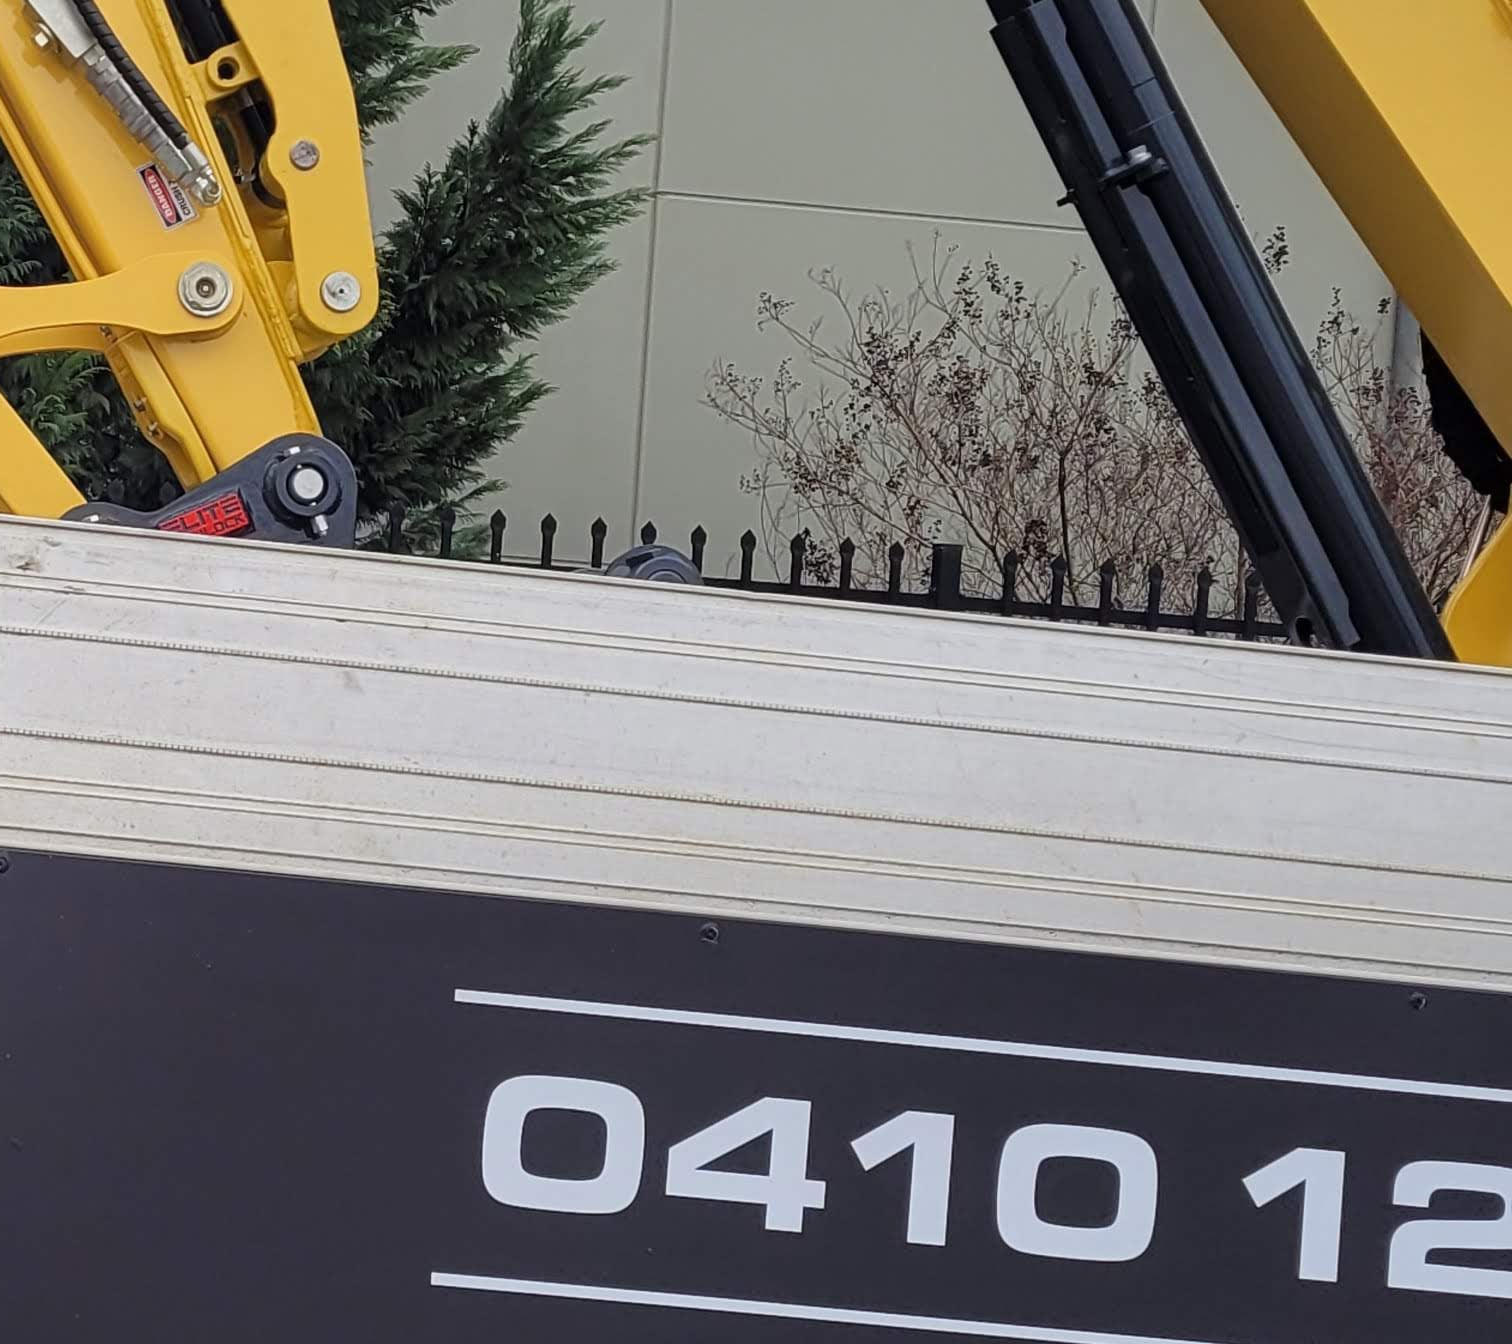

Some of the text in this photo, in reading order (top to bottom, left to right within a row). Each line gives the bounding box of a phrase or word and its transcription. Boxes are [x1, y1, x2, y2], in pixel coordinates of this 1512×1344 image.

[148, 175, 173, 217] DANGER
[481, 1074, 1512, 1299] 0410 12
